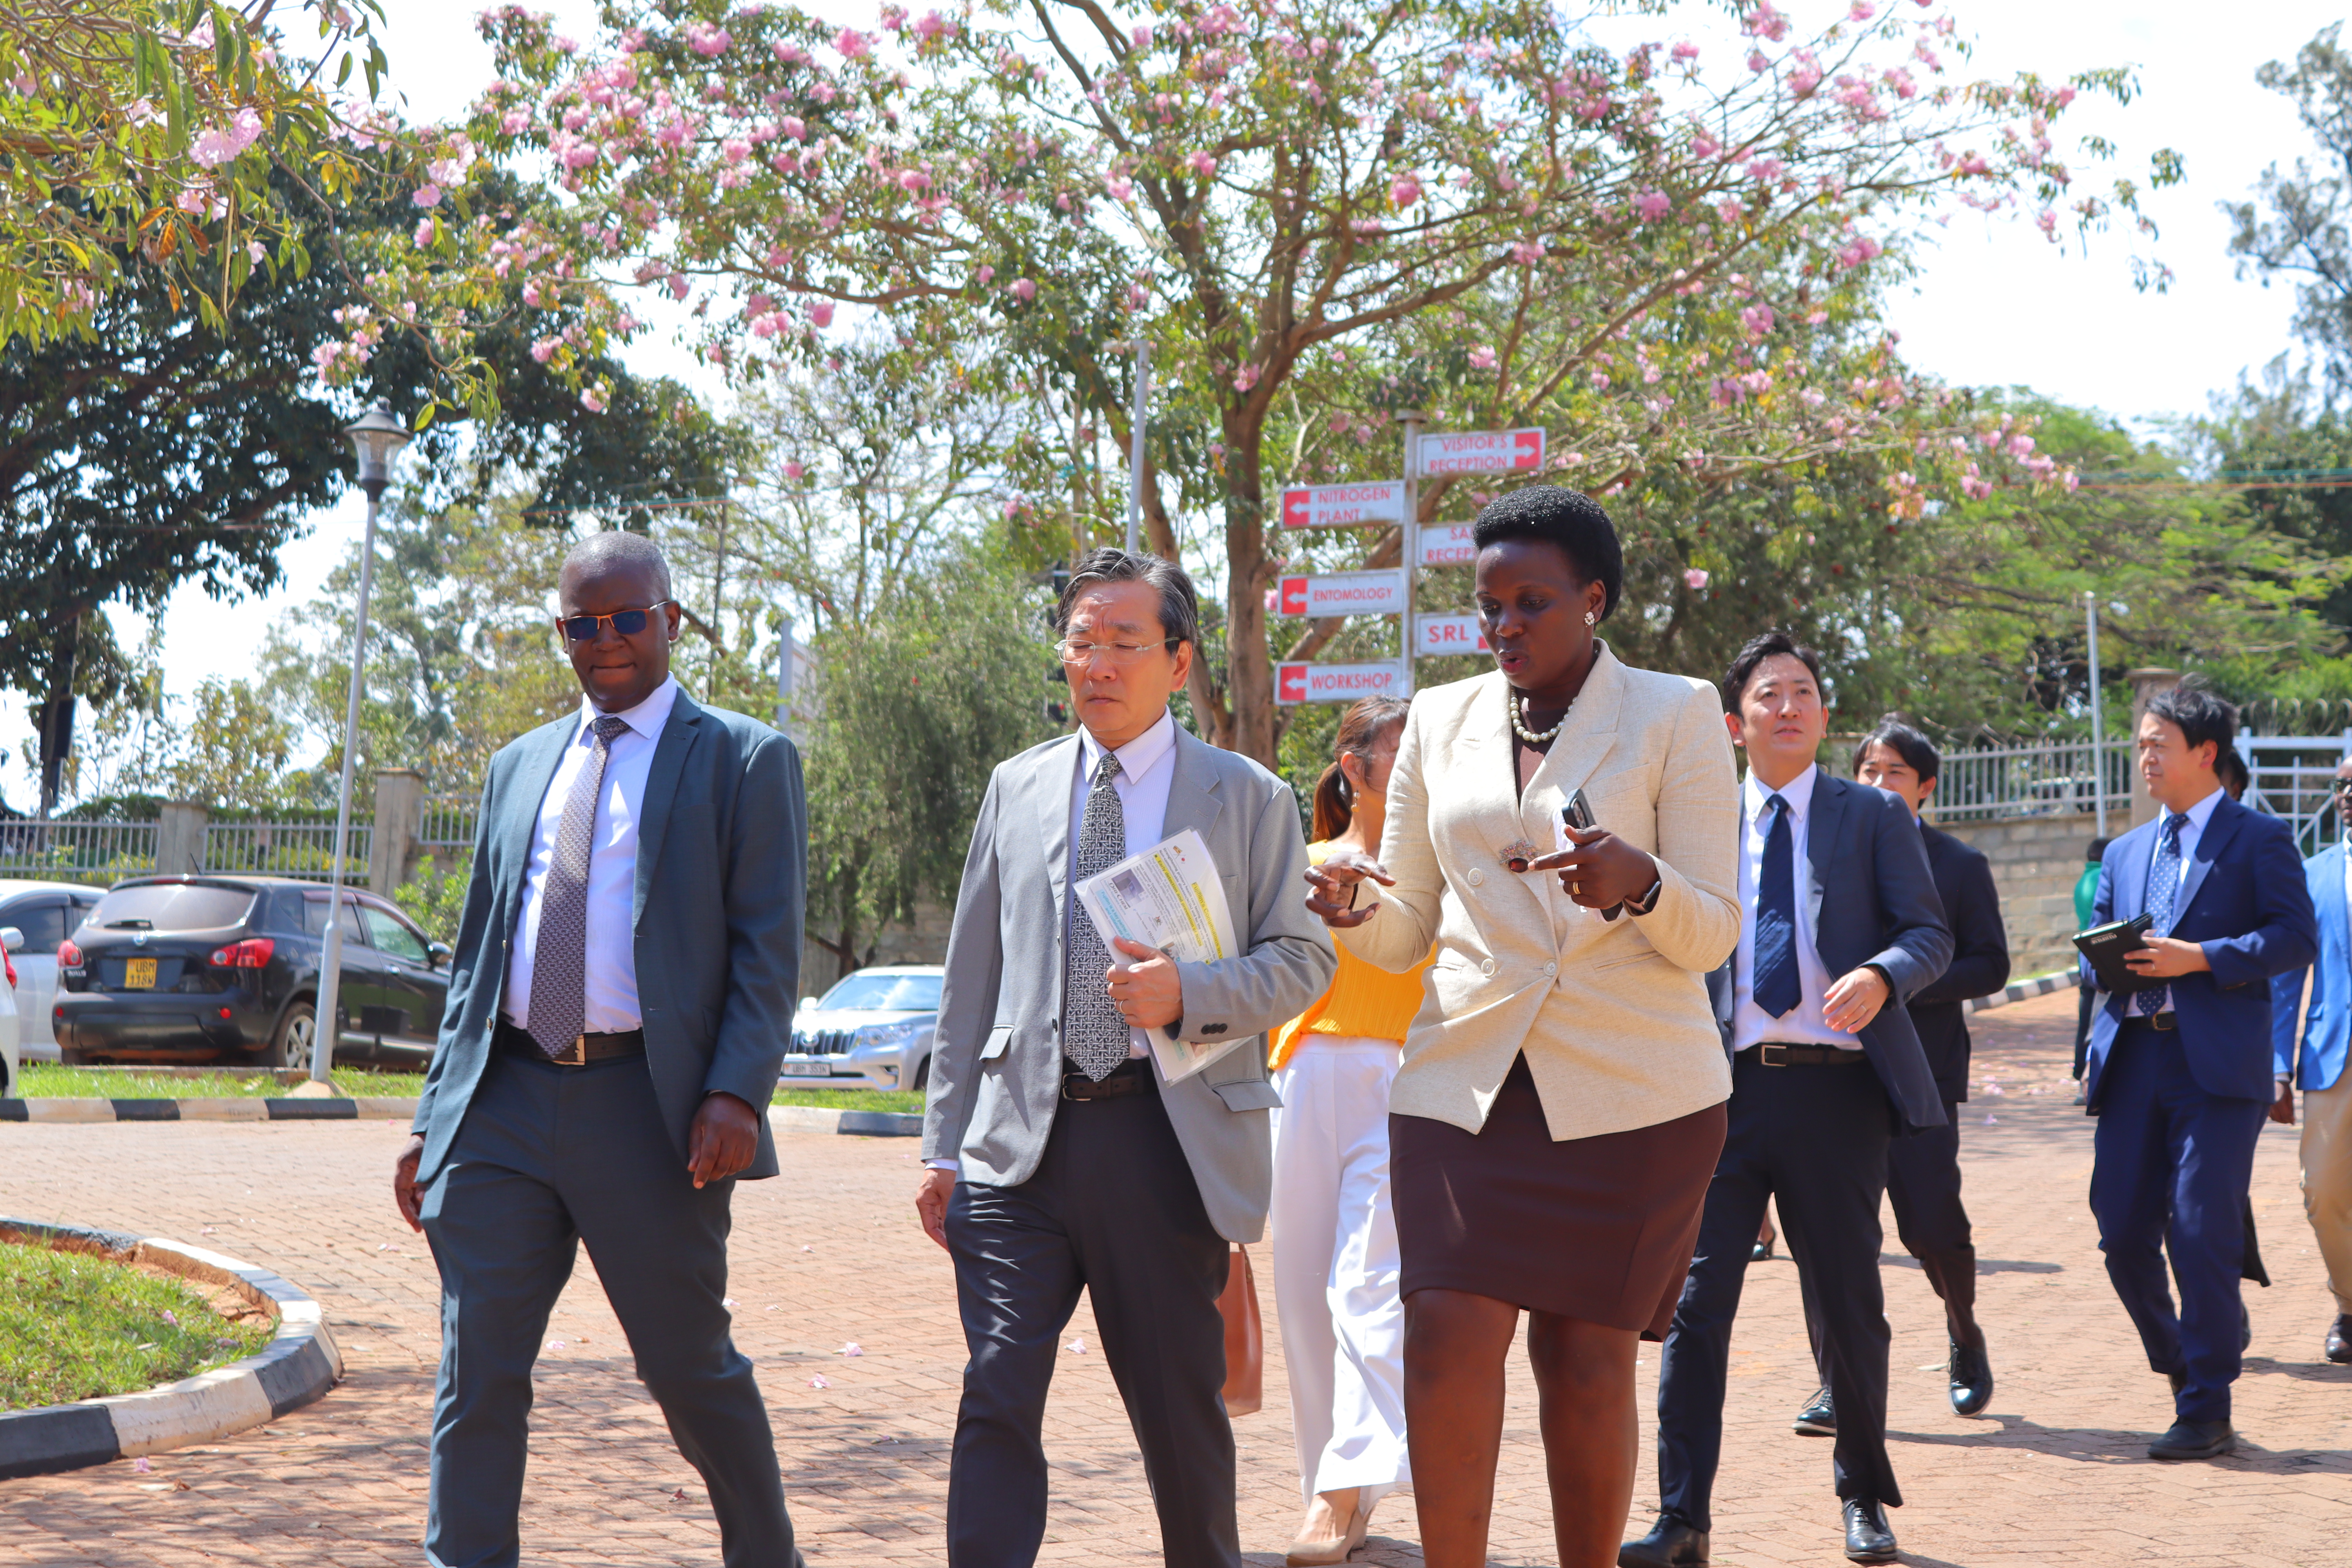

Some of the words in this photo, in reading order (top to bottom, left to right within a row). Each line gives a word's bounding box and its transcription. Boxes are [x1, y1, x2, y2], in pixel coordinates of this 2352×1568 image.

[1442, 435, 1507, 452] VISITOR'S
[1429, 456, 1507, 472] RECEPTION
[1319, 487, 1390, 503] NITROGEN
[1319, 508, 1360, 523] PLANT
[1314, 588, 1392, 602] ENTOMOLOGY
[1428, 624, 1469, 643] SRL
[1312, 673, 1392, 689] WORKSHOP
[1159, 849, 1180, 882] Non-communicable
[1163, 847, 1179, 871] Strengthening
[1176, 871, 1186, 886] primary
[1107, 881, 1128, 909] DRI-CHEM
[1158, 860, 1167, 871] Early
[1165, 871, 1178, 893] detection
[1181, 902, 1195, 927] prevention
[1192, 882, 1206, 907] Fujifilm's
[1203, 908, 1220, 946] Contributions
